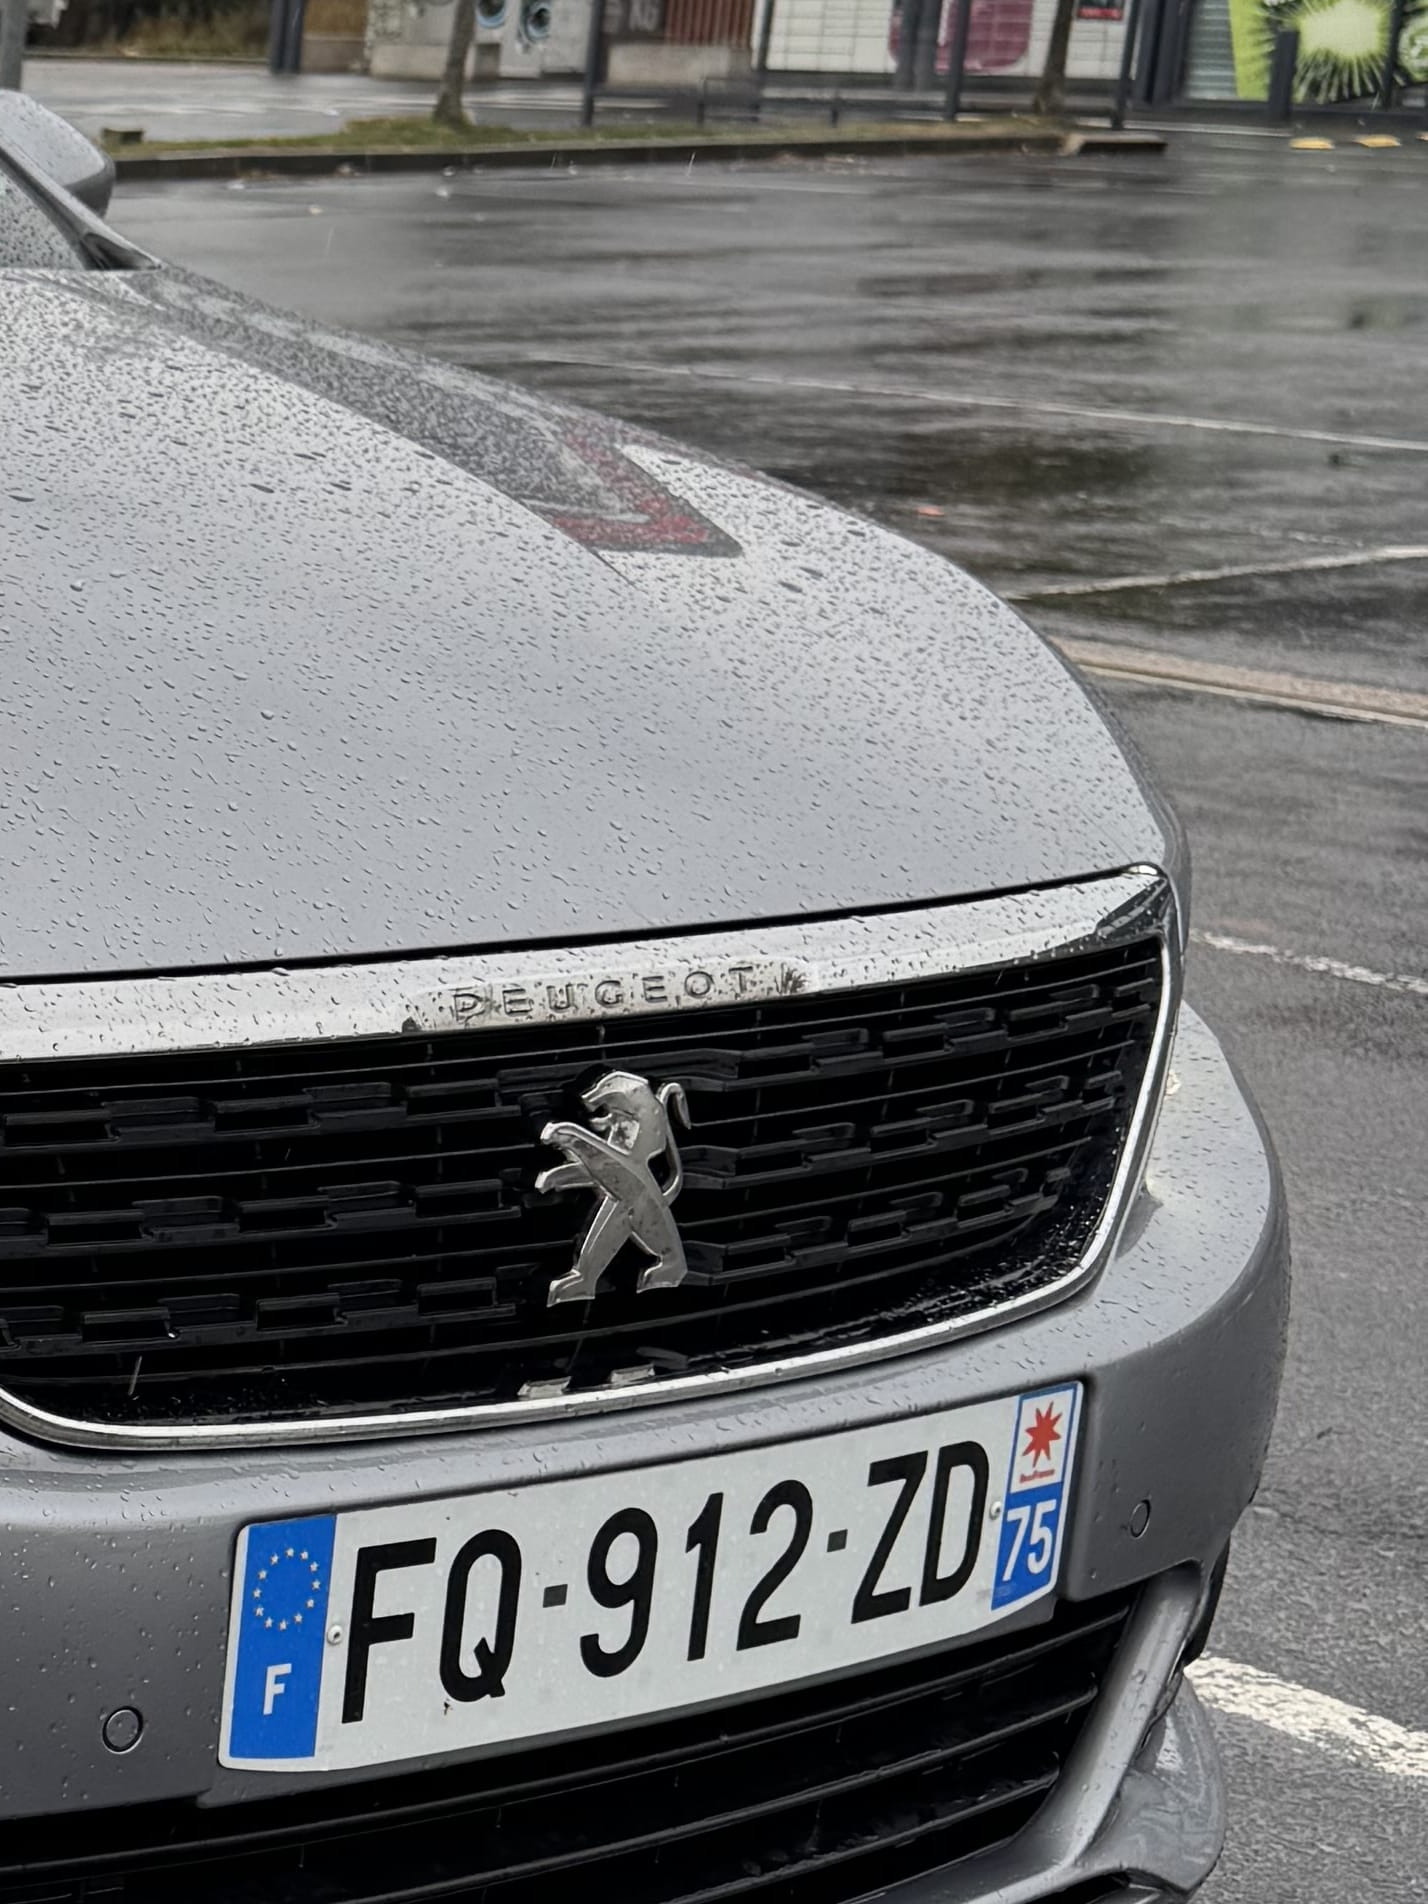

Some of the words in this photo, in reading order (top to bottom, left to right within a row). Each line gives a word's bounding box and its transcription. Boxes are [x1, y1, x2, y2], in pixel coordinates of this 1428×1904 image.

[451, 965, 756, 1023] PEUGEOT
[1001, 1498, 1057, 1582] 75
[342, 1440, 990, 1725] FQ-912-ZD
[263, 1663, 293, 1717] F
